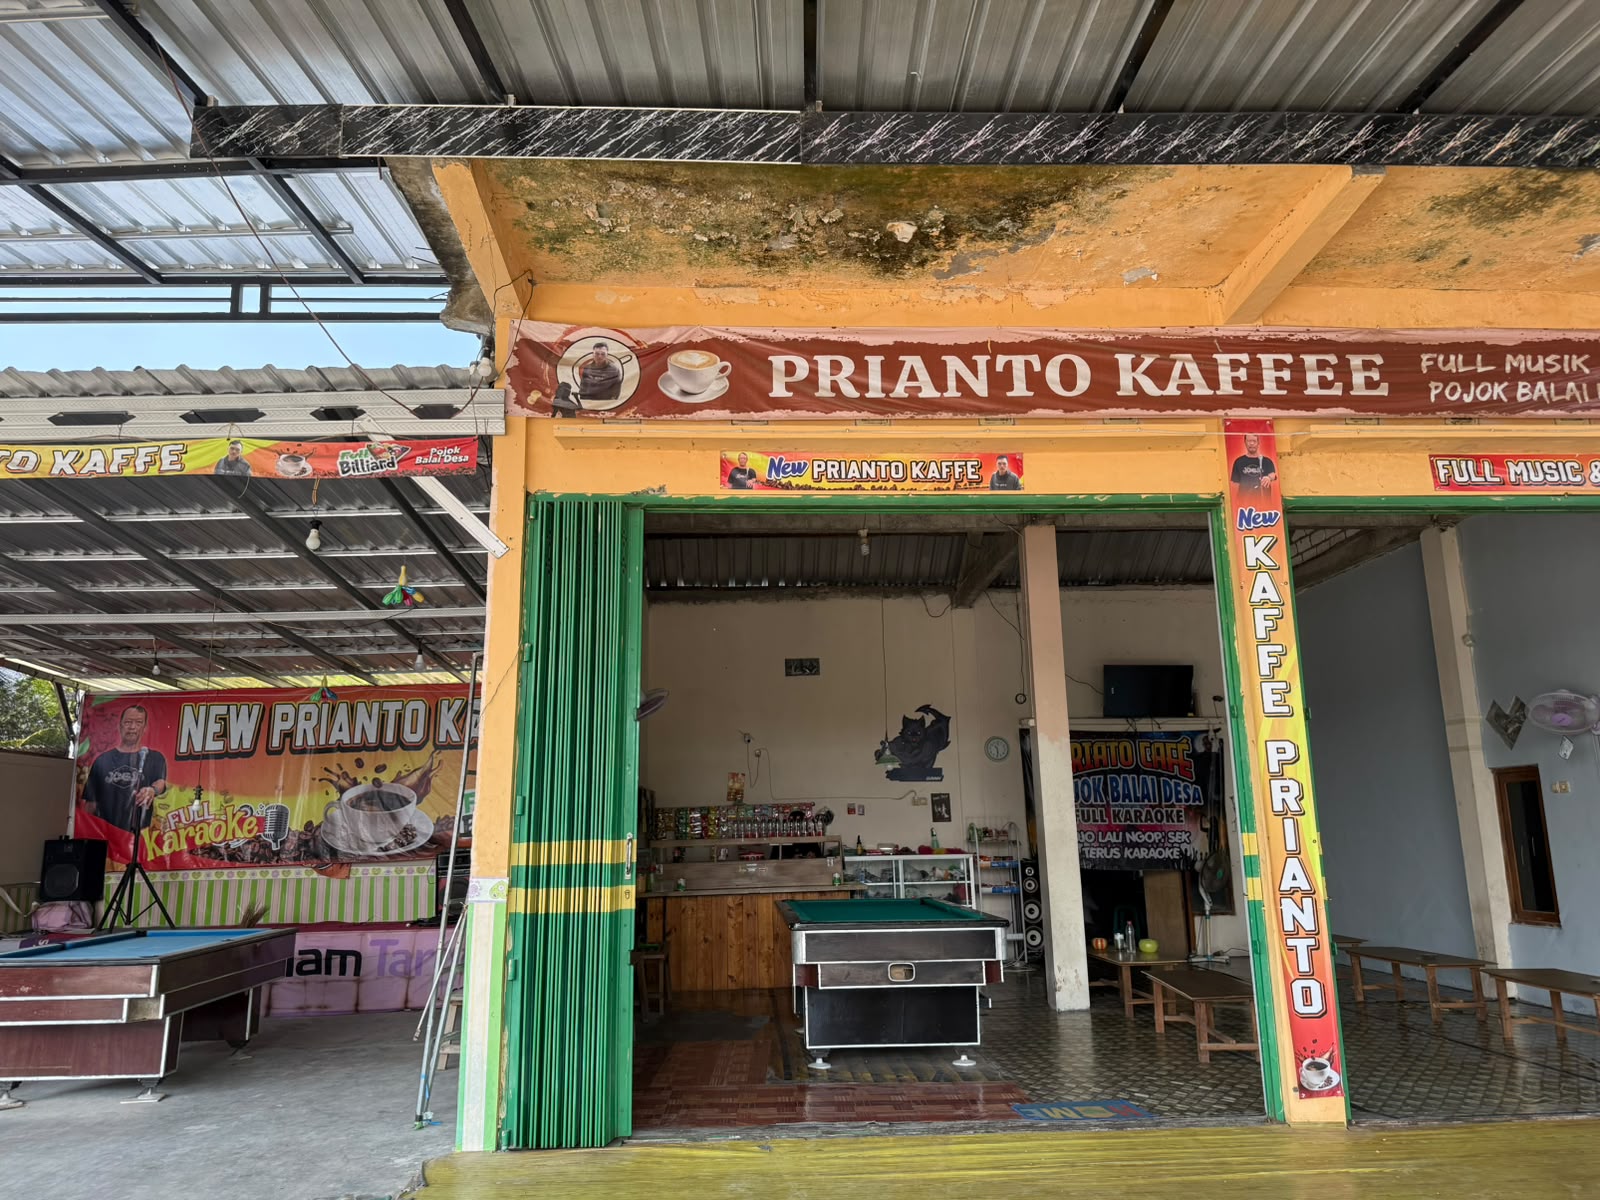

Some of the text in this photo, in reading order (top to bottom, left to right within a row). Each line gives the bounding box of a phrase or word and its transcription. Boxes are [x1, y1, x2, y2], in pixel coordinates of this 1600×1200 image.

[1420, 353, 1591, 374] FULL MUSIK
[767, 353, 1389, 398] PRIANTO KAFFEE
[1428, 381, 1509, 403] POJOK
[1516, 381, 1590, 404] BALAI
[49, 443, 187, 476] KAFFE
[340, 449, 369, 460] Full
[415, 454, 469, 465] Balai Desa
[430, 446, 461, 458] Pojok
[338, 456, 397, 475] Billiard
[766, 455, 982, 482] New PRIANTO KAFFE
[1435, 459, 1504, 486] FULL
[1506, 459, 1587, 486] MUSIC
[1236, 507, 1280, 530] New
[1243, 535, 1293, 718] KAFFE
[176, 703, 263, 760] NEW
[267, 698, 432, 754] PRIANTO
[1108, 774, 1159, 804] BALAI
[1161, 777, 1204, 805] DESA
[167, 801, 214, 830] FULL
[1111, 807, 1184, 824] KARAOKE
[1167, 831, 1190, 843] SEK
[1082, 847, 1180, 859] TERUS KARAOKE
[1264, 739, 1328, 1018] PRIANTO
